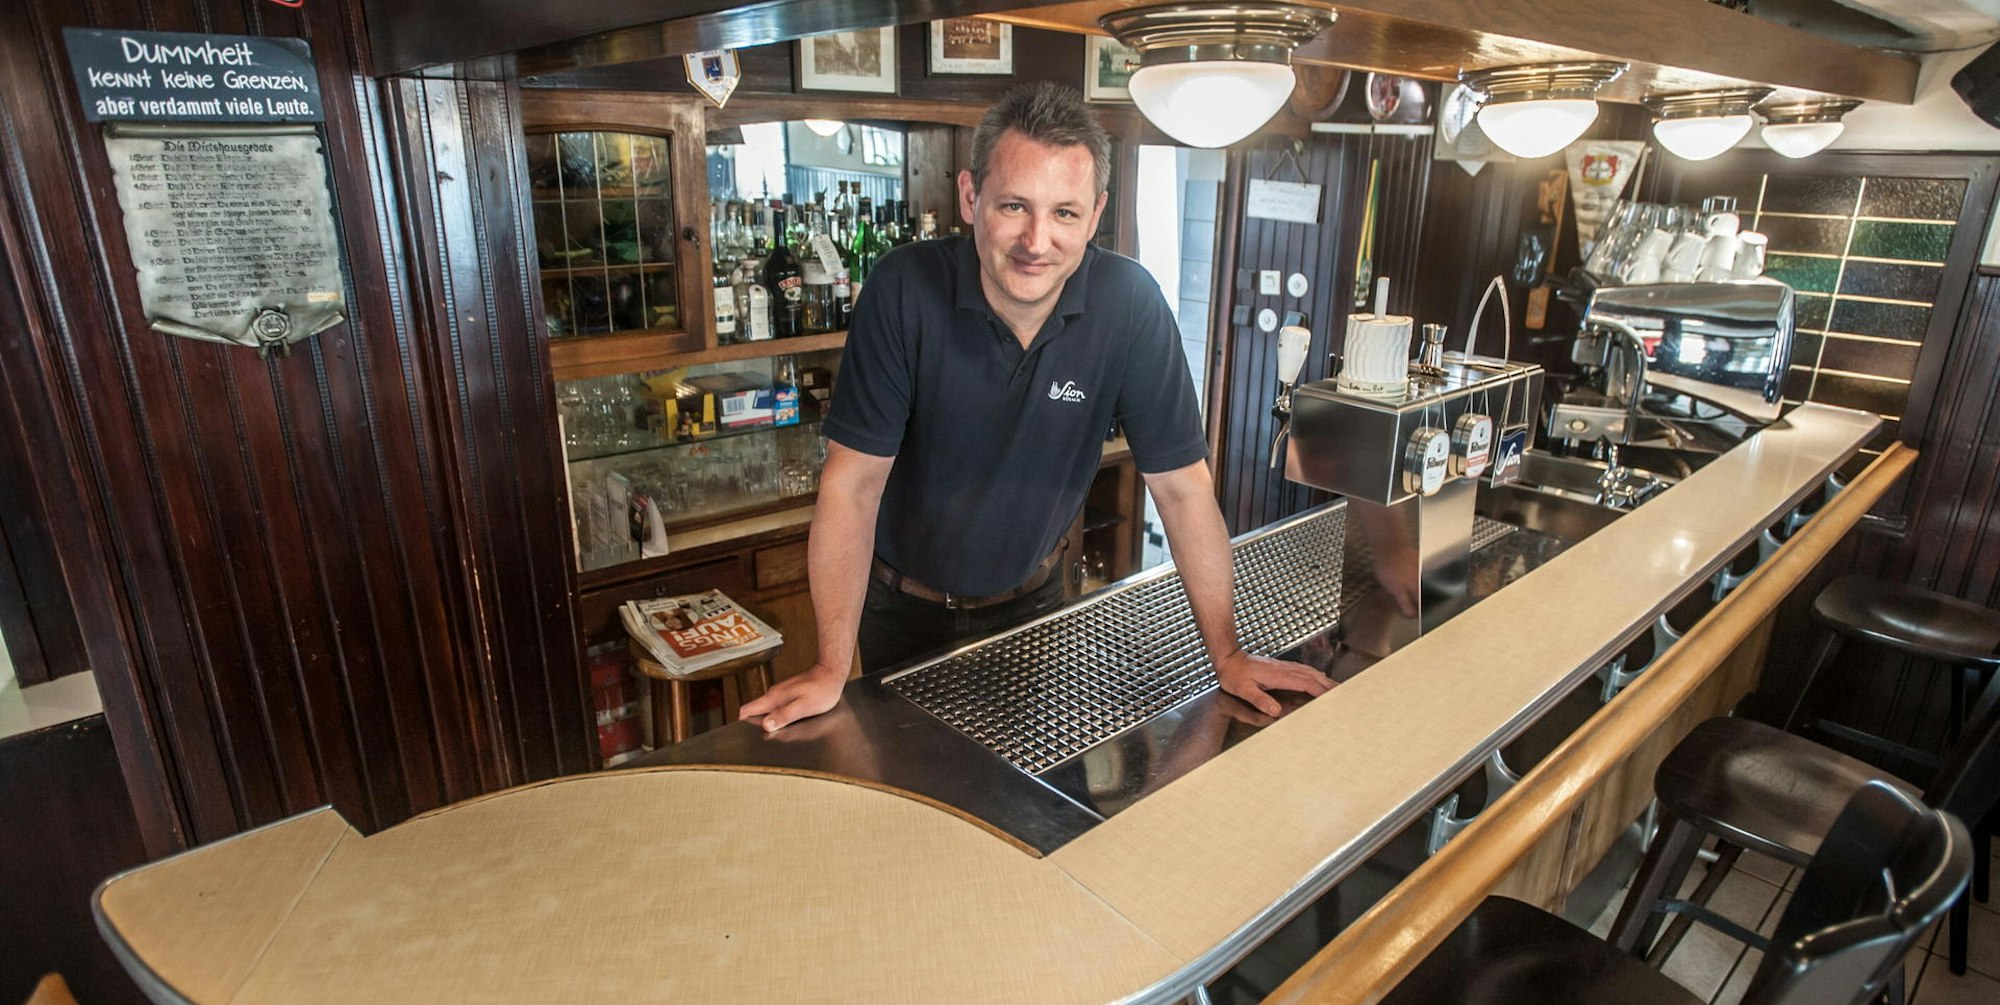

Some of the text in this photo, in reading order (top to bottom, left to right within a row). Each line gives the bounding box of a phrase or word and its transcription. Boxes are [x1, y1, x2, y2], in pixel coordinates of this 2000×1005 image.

[96, 96, 315, 115] aber verdammt viele Leute.
[670, 613, 737, 642] AUF!
